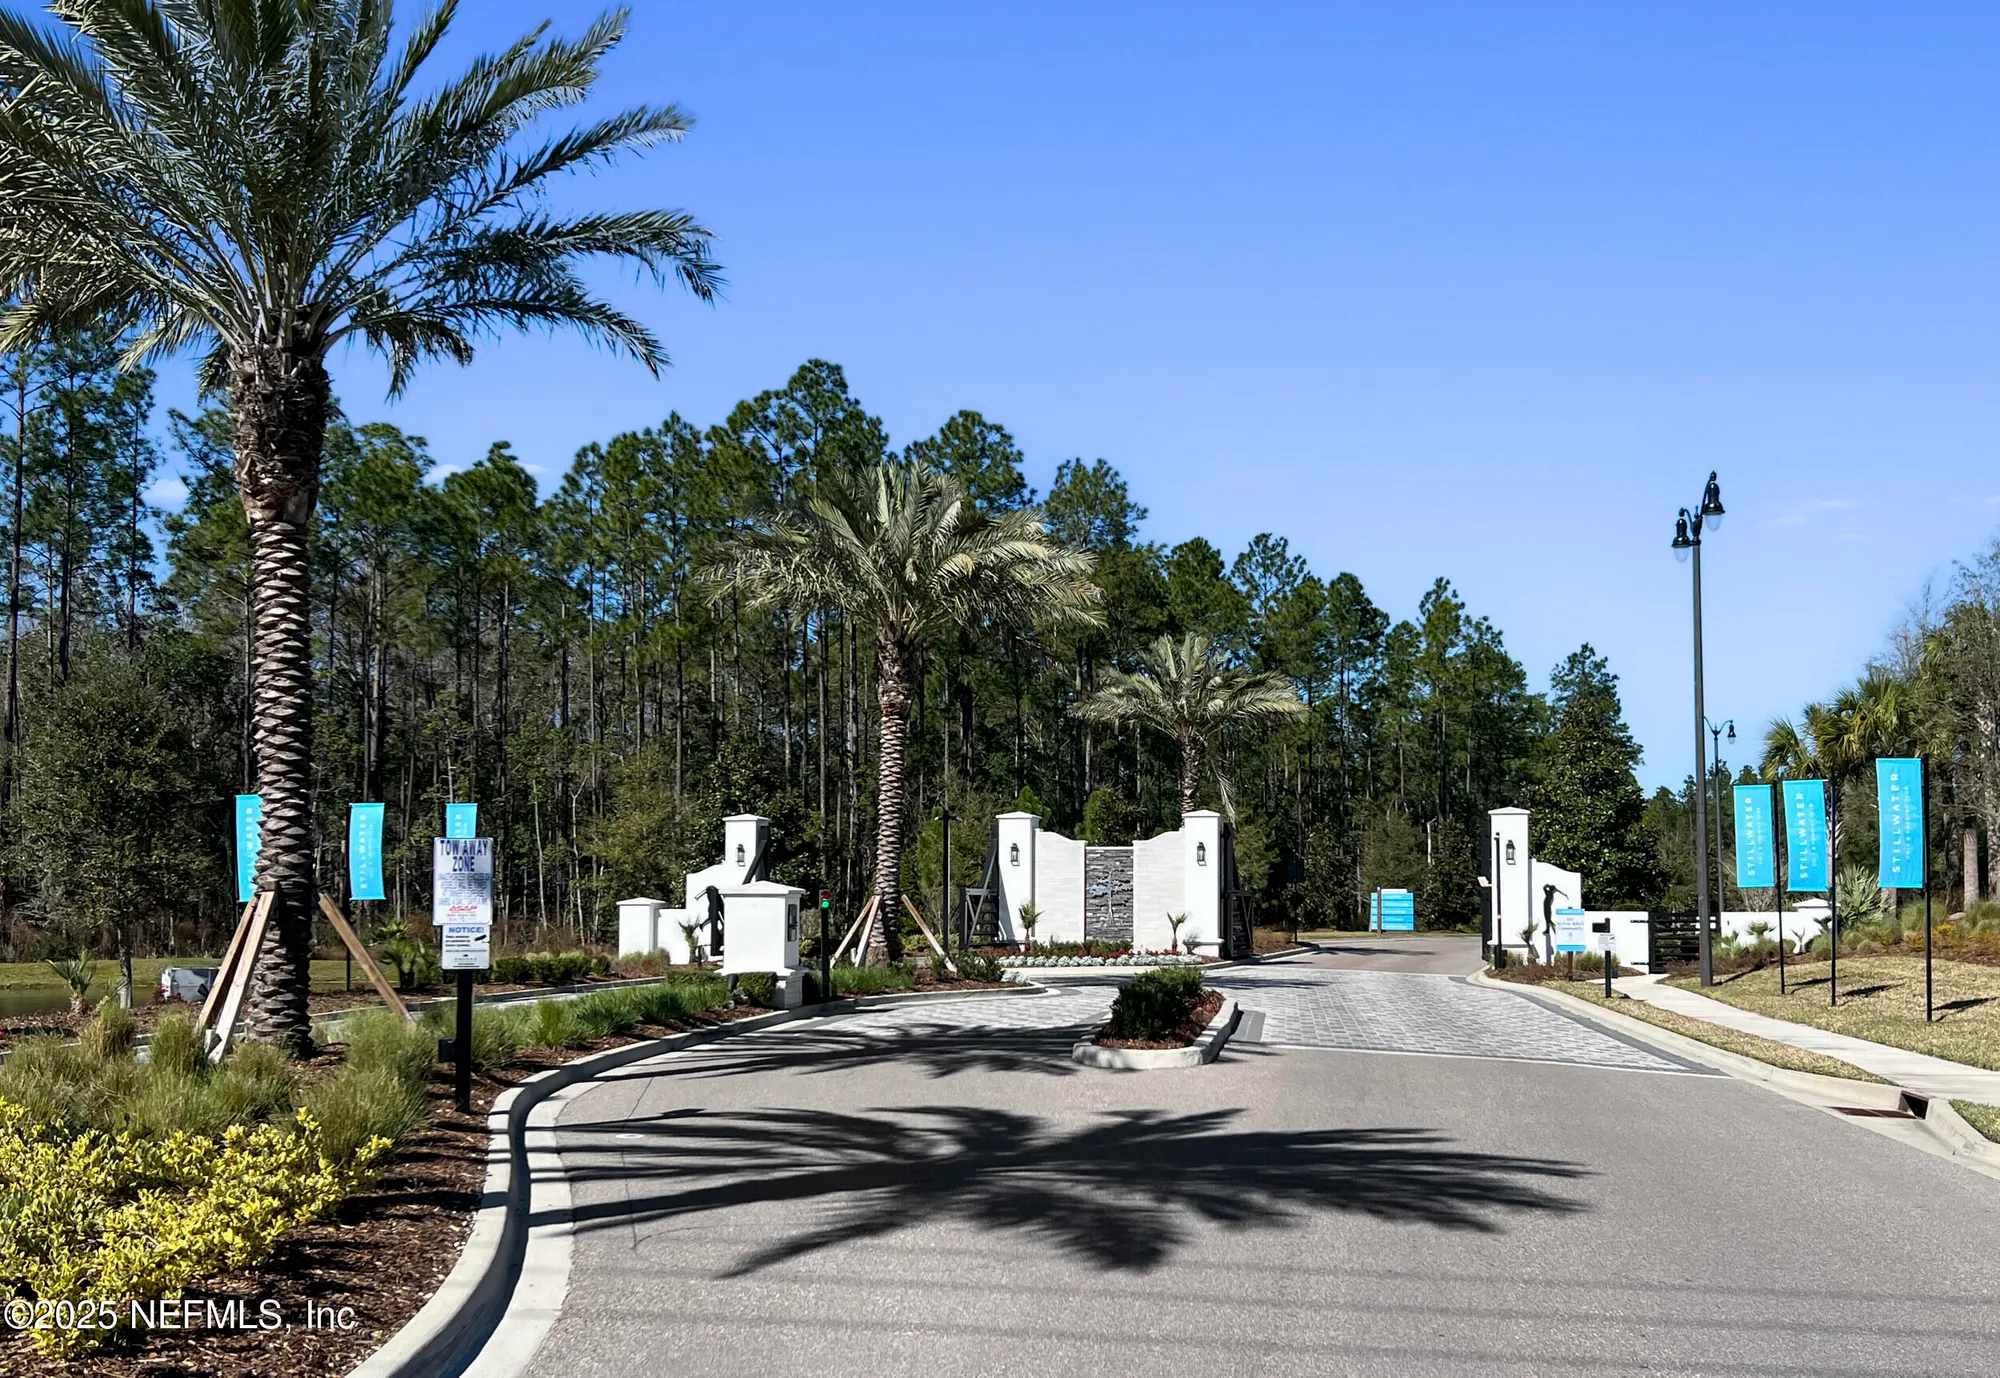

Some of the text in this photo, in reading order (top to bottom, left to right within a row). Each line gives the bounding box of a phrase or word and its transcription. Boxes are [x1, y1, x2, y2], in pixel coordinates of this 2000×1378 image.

[359, 814, 368, 889] STILLWATER
[440, 839, 488, 856] TOW AWAY
[1744, 797, 1756, 876] STILLWATER
[1796, 793, 1808, 878] STILLWATER
[1890, 773, 1902, 873] STILLWATER
[452, 856, 475, 872] ZONE
